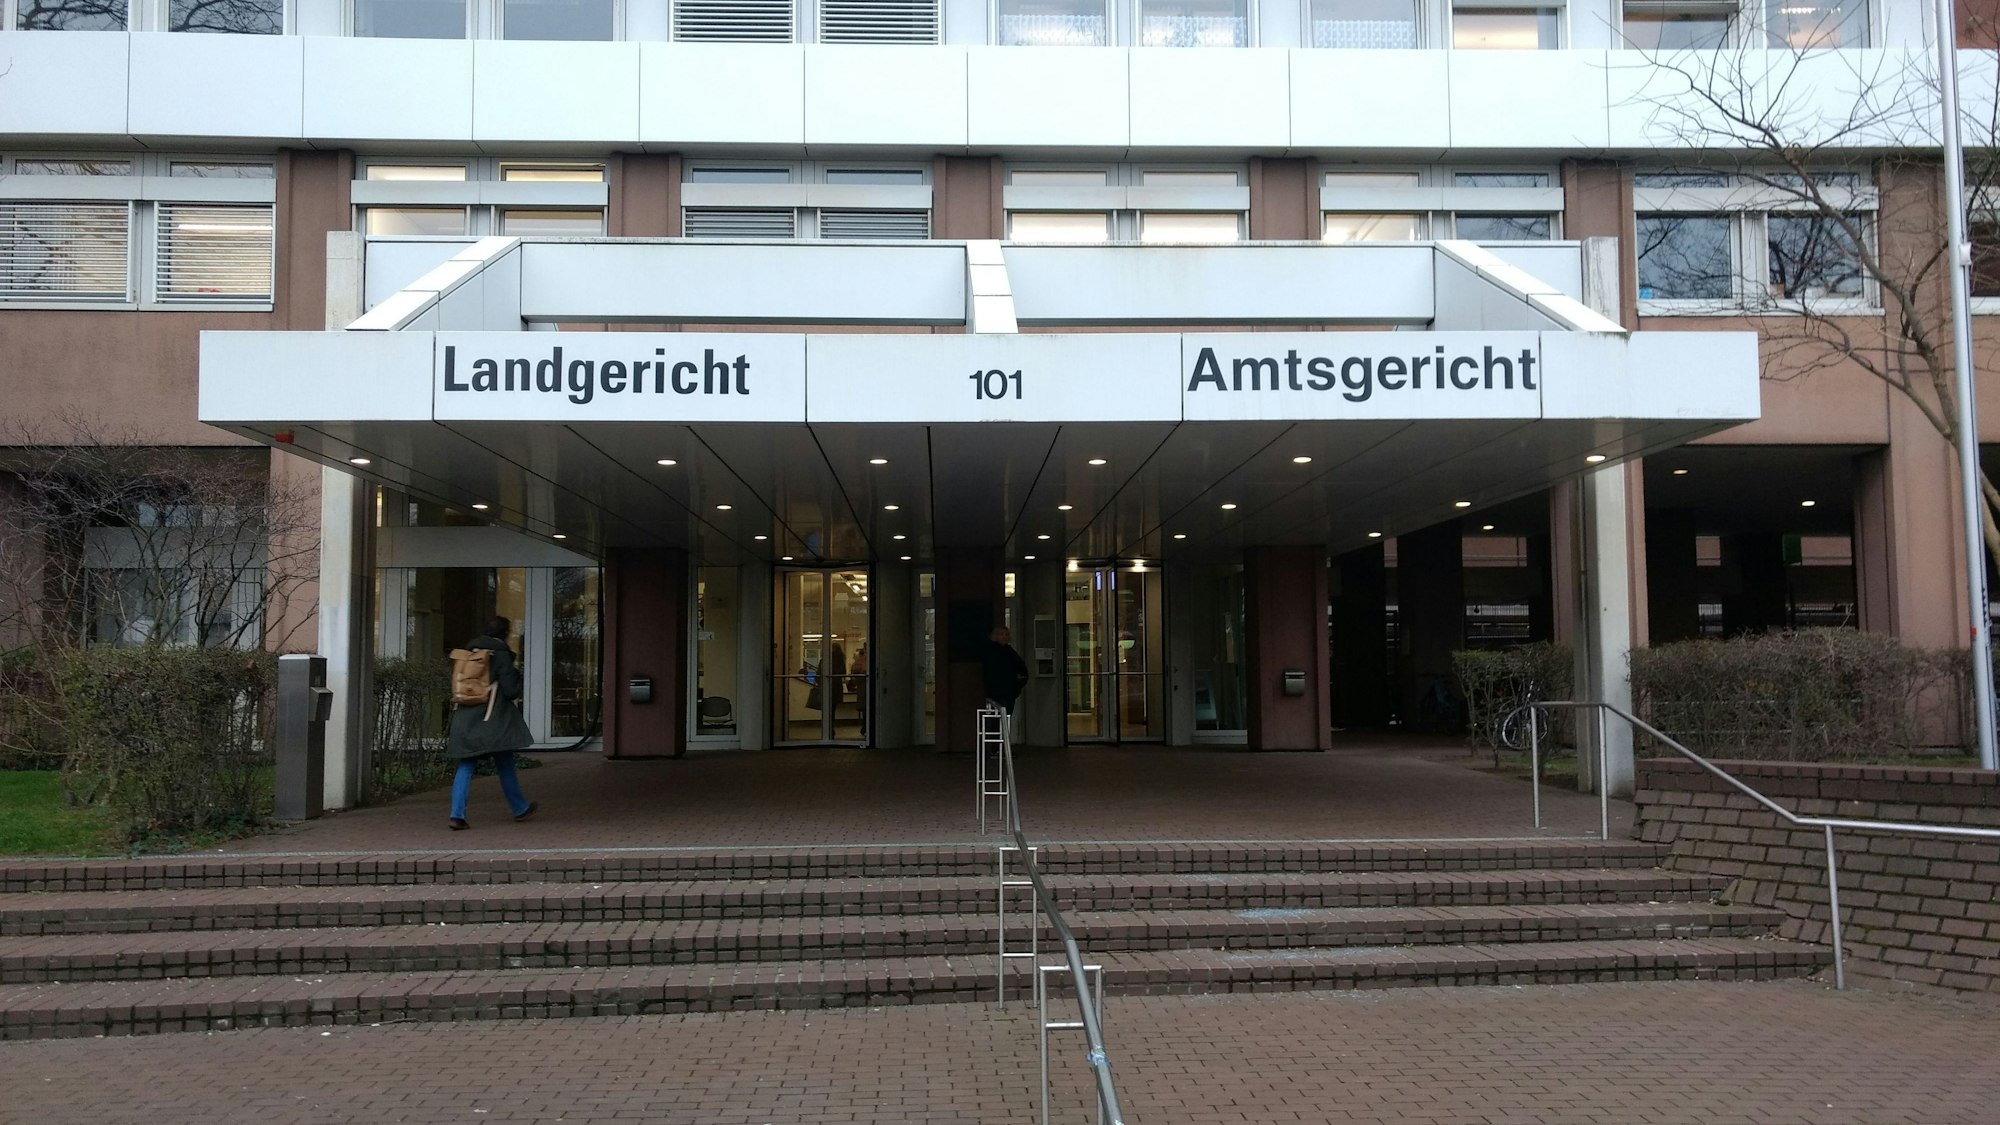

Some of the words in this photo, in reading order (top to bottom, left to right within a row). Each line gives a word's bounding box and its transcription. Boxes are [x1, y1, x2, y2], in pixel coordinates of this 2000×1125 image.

[444, 345, 750, 405] Landgericht
[969, 369, 1022, 400] 101
[1187, 345, 1537, 403] Amtsgericht
